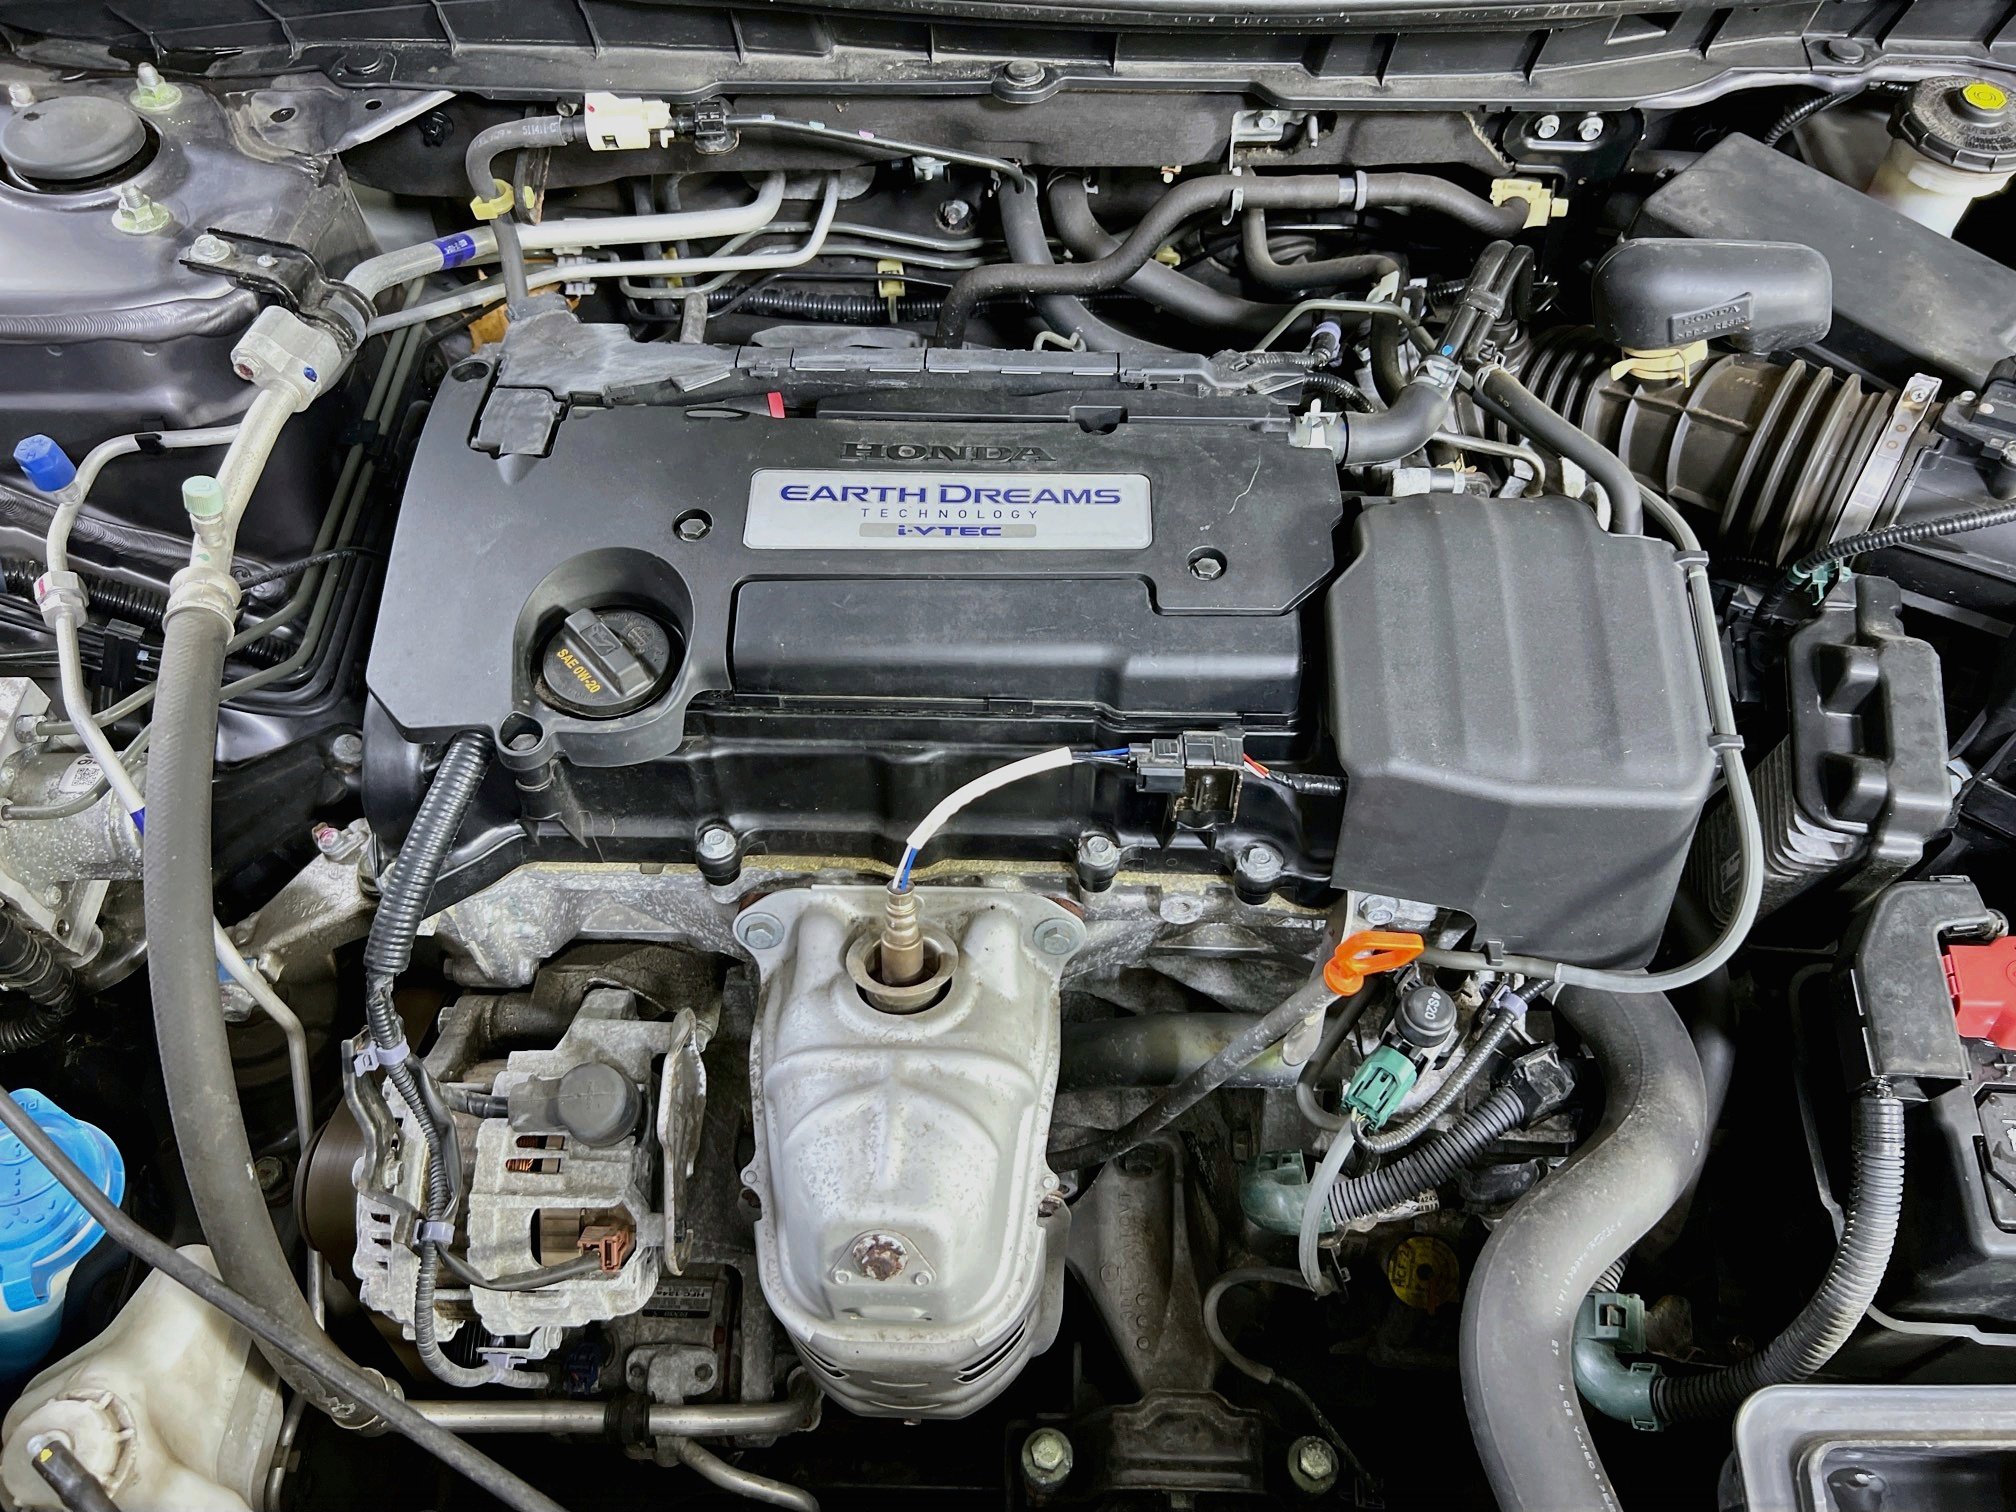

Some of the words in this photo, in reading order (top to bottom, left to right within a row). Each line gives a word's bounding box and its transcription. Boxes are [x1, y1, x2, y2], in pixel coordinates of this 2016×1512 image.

[1682, 304, 1740, 325] HONDA
[838, 441, 1058, 463] HONDA
[780, 484, 927, 504] EARTH
[939, 483, 1122, 505] DREAMS
[861, 507, 1039, 520] TECHNOLOGY
[897, 522, 1002, 537] i-VTEC
[556, 647, 580, 670] SAE
[572, 665, 601, 694] 0W-20
